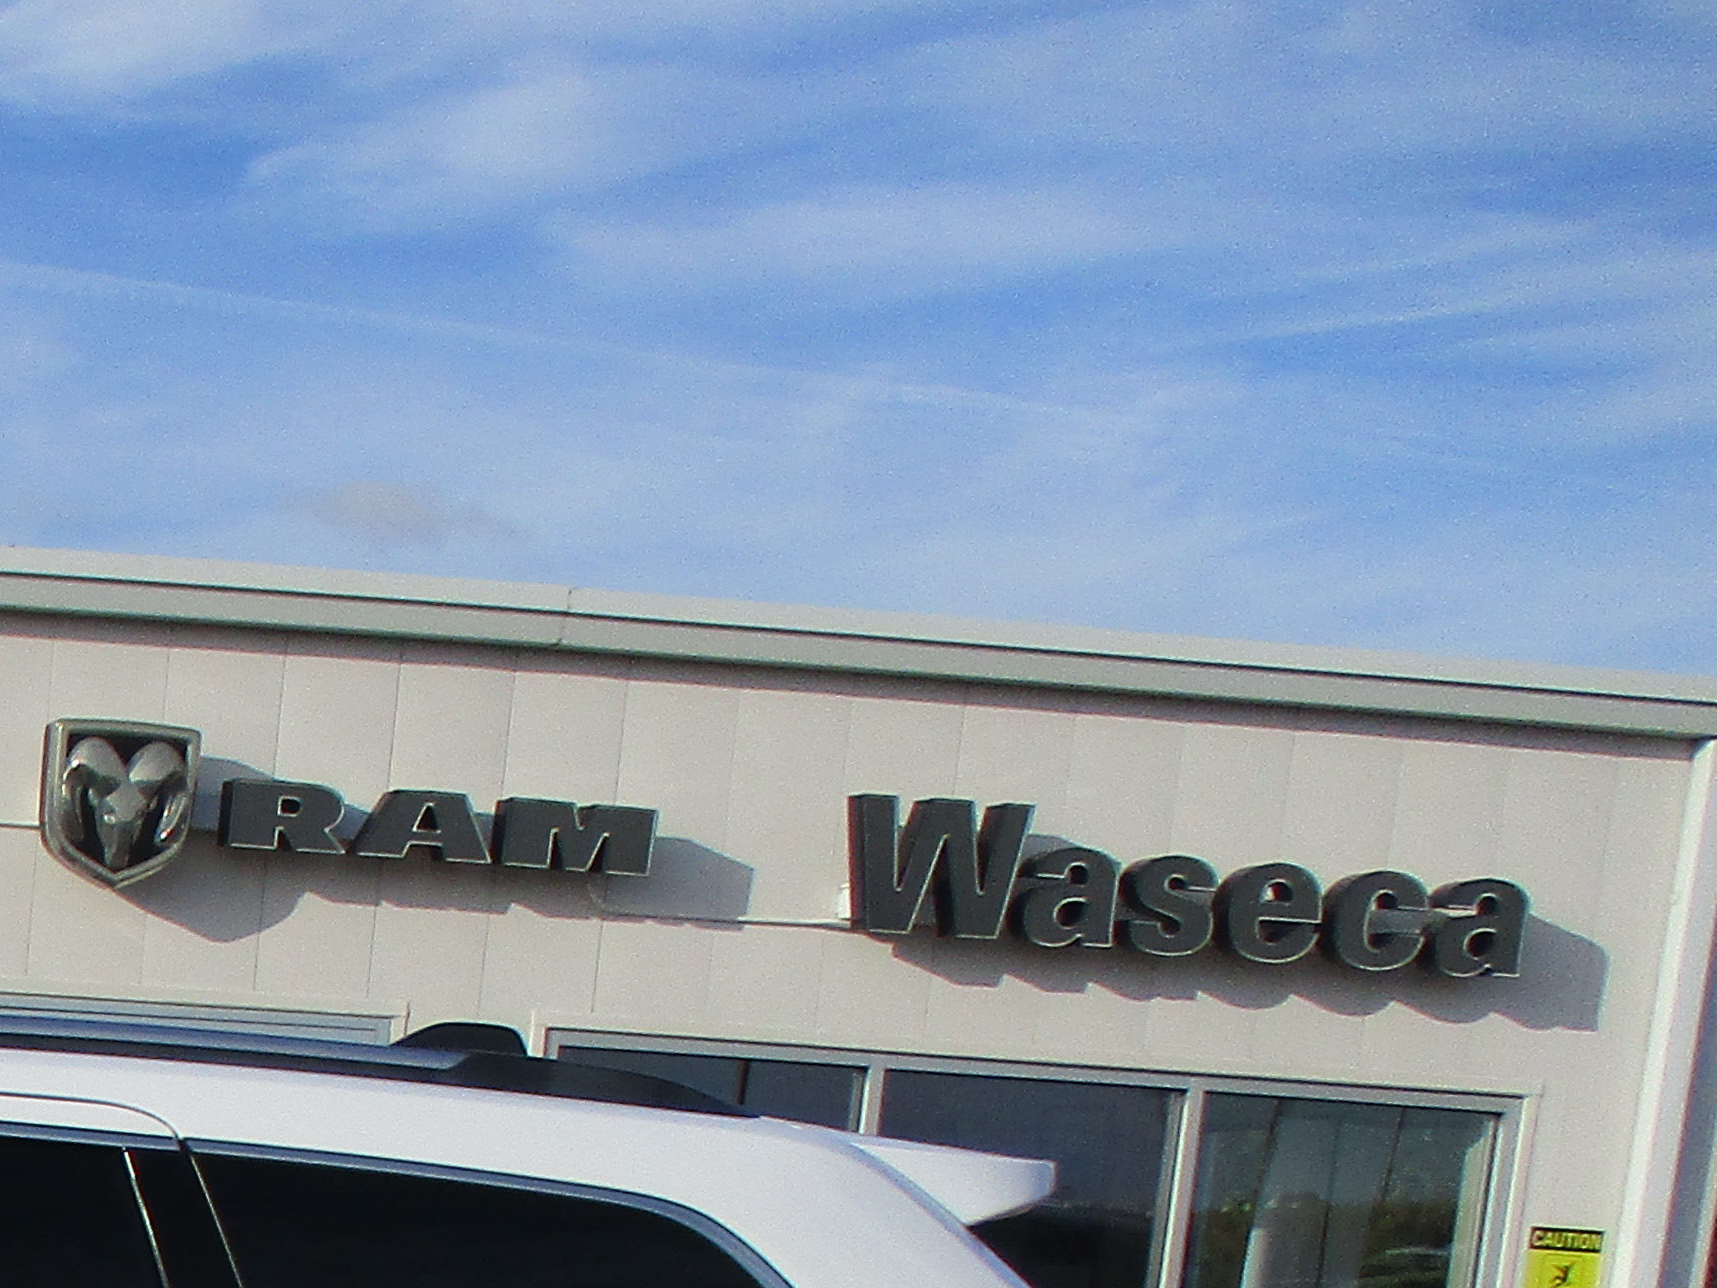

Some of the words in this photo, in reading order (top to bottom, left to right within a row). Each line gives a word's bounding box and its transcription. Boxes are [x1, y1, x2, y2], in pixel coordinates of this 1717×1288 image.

[221, 778, 660, 877] RAM
[848, 793, 1530, 979] Waseca
[1531, 1230, 1602, 1251] CAUTION
